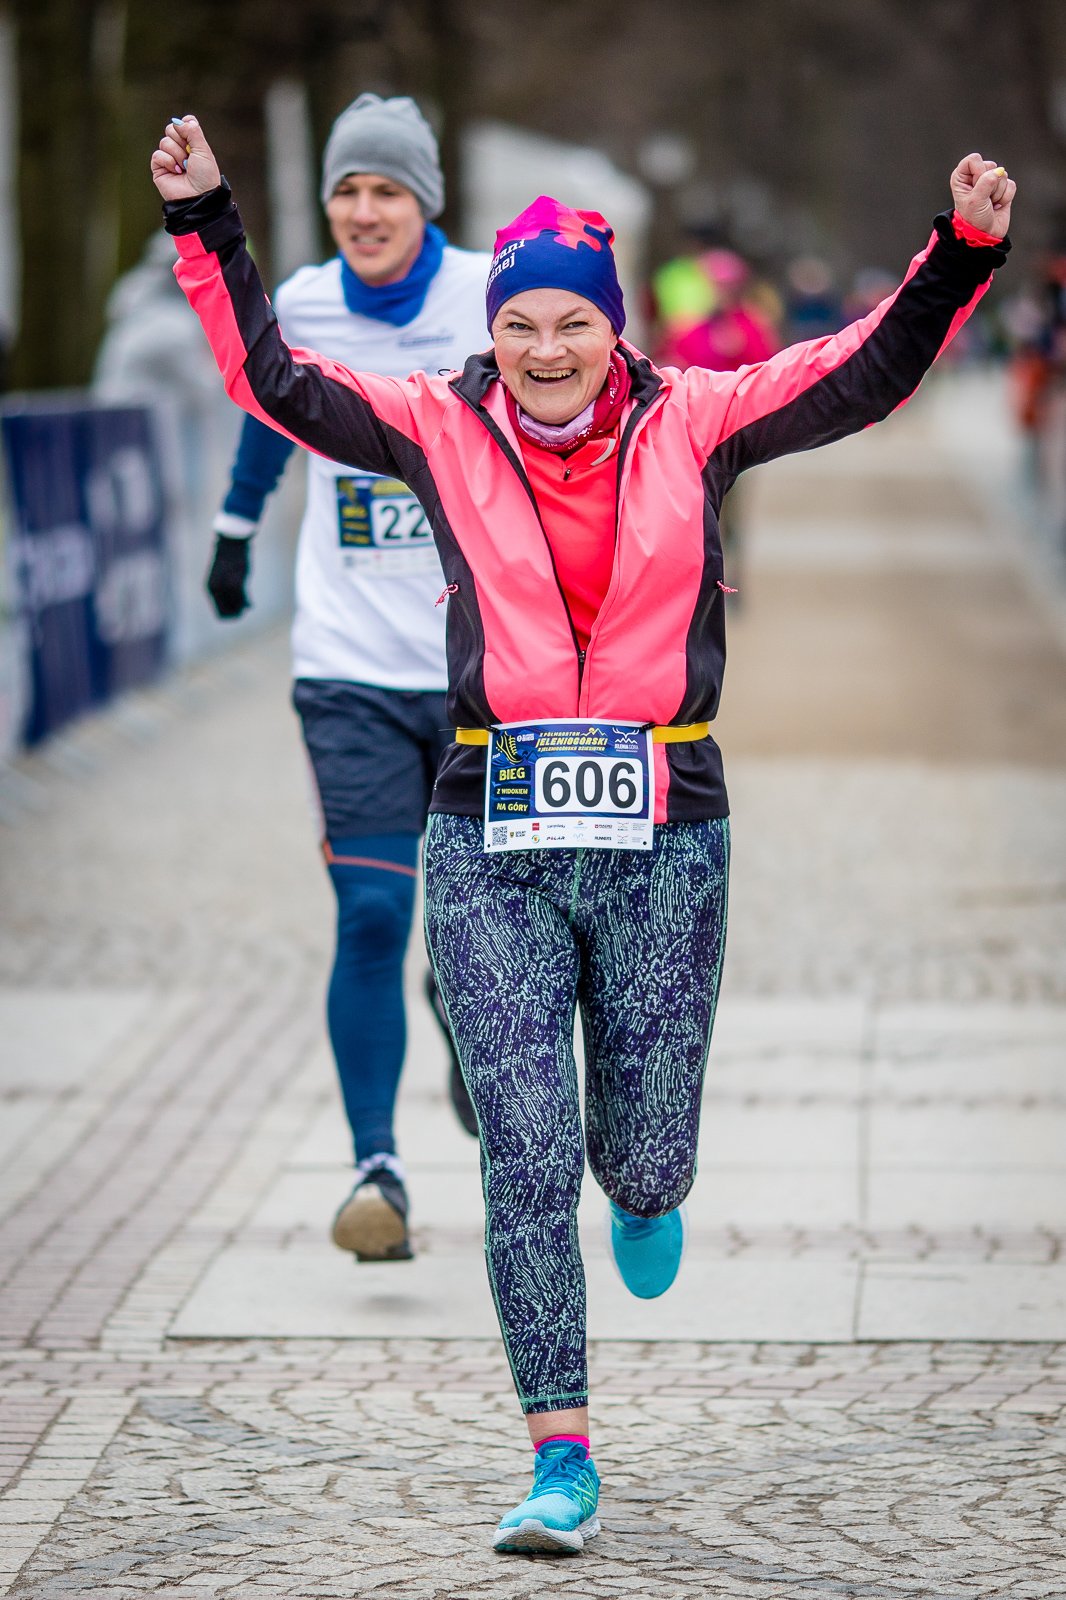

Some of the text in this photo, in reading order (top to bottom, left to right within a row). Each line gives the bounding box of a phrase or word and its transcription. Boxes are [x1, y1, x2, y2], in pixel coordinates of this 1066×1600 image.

[491, 238, 525, 268] gani
[535, 736, 608, 748] JELENIOGÓRSKI
[499, 767, 526, 781] BIEG
[542, 760, 637, 809] 606
[496, 802, 529, 811] NA GÓRY
